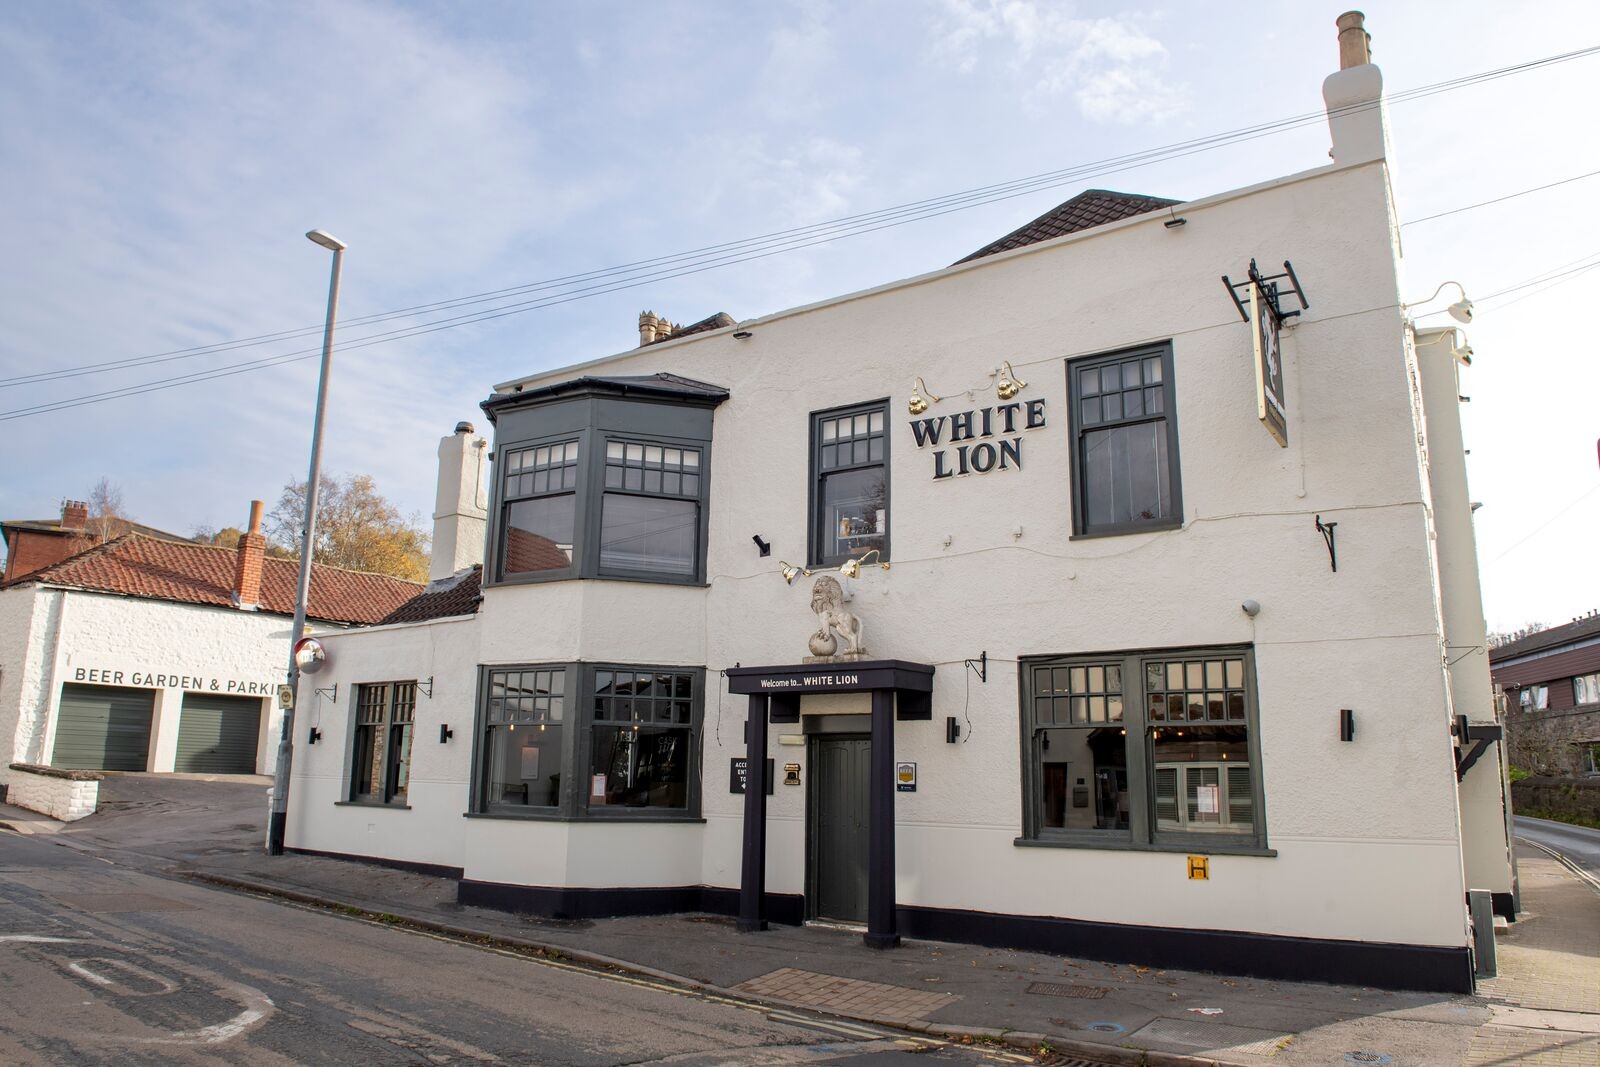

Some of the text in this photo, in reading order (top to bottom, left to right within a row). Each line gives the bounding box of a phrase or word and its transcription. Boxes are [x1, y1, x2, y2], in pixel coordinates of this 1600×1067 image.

[909, 398, 1046, 448] WHITE
[932, 437, 1022, 480] LION
[75, 668, 280, 696] BEER GARDEN & PARKI
[760, 679, 789, 688] Welcome
[803, 676, 833, 686] WHITE
[835, 675, 858, 685] LION
